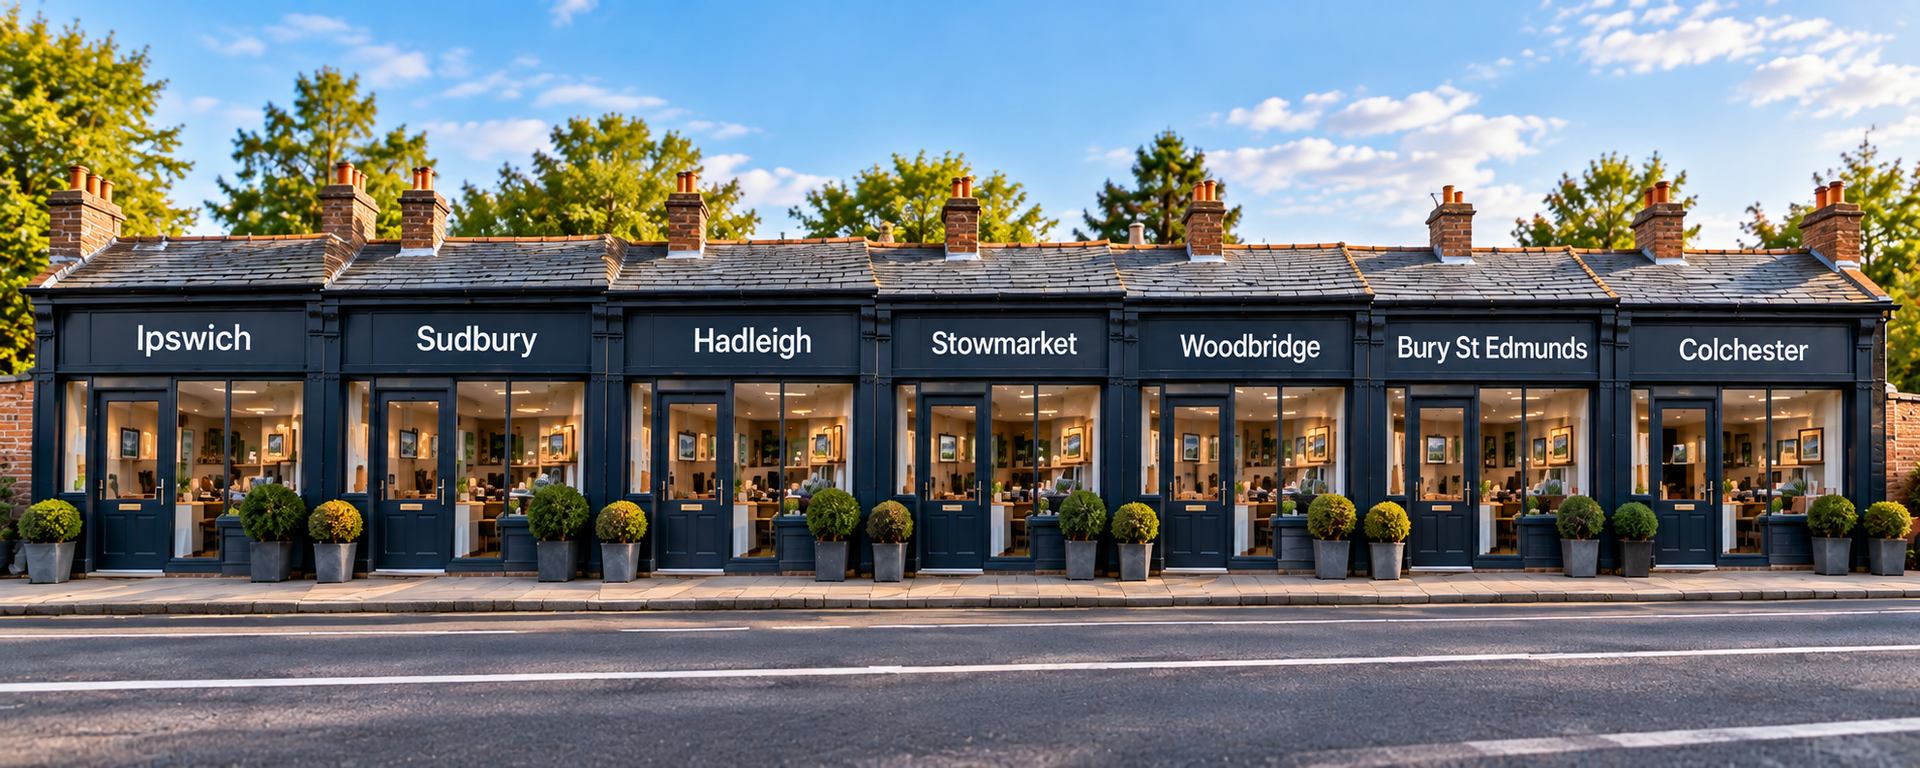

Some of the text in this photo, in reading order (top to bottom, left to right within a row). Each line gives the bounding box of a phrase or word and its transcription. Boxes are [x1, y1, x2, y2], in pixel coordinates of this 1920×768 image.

[137, 323, 251, 358] Ipswich
[416, 325, 538, 358] Sudbury
[694, 326, 812, 360] Hadleigh
[931, 330, 1078, 356] Stowmarket
[1179, 333, 1321, 364] Woodbridge
[1398, 335, 1588, 365] Bury St Edmunds
[1679, 337, 1809, 362] Colchester
